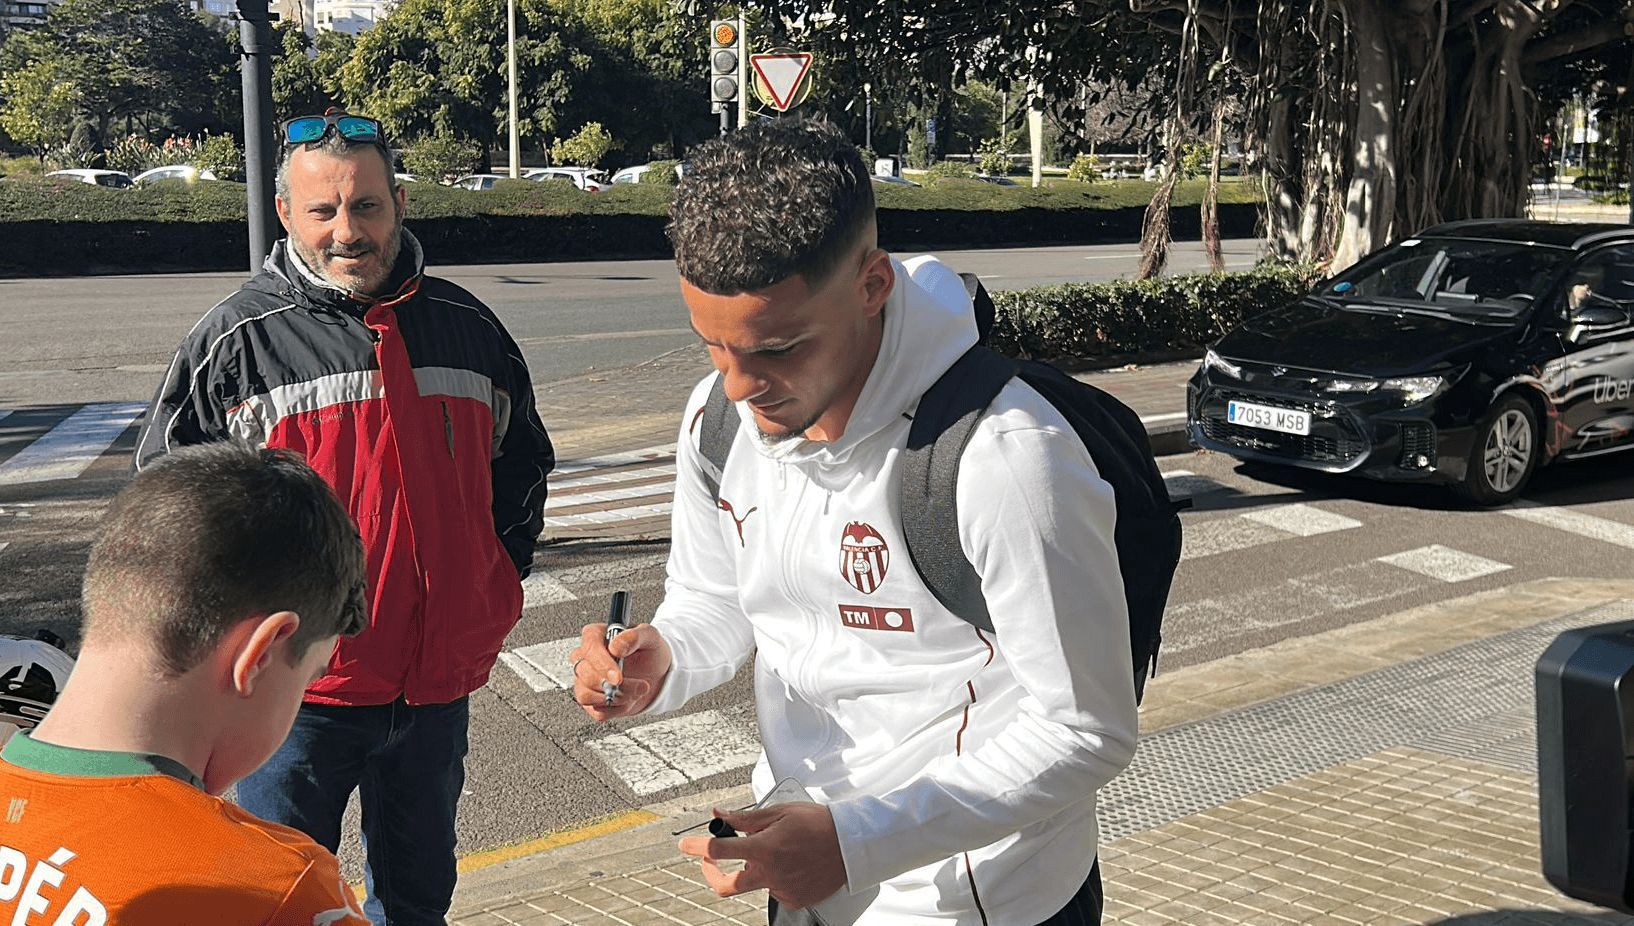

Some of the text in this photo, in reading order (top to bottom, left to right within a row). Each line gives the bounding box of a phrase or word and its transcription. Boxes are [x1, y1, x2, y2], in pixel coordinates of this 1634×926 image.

[1594, 376, 1634, 404] Uber
[1238, 406, 1305, 431] 7053 MSB
[843, 610, 870, 625] TM
